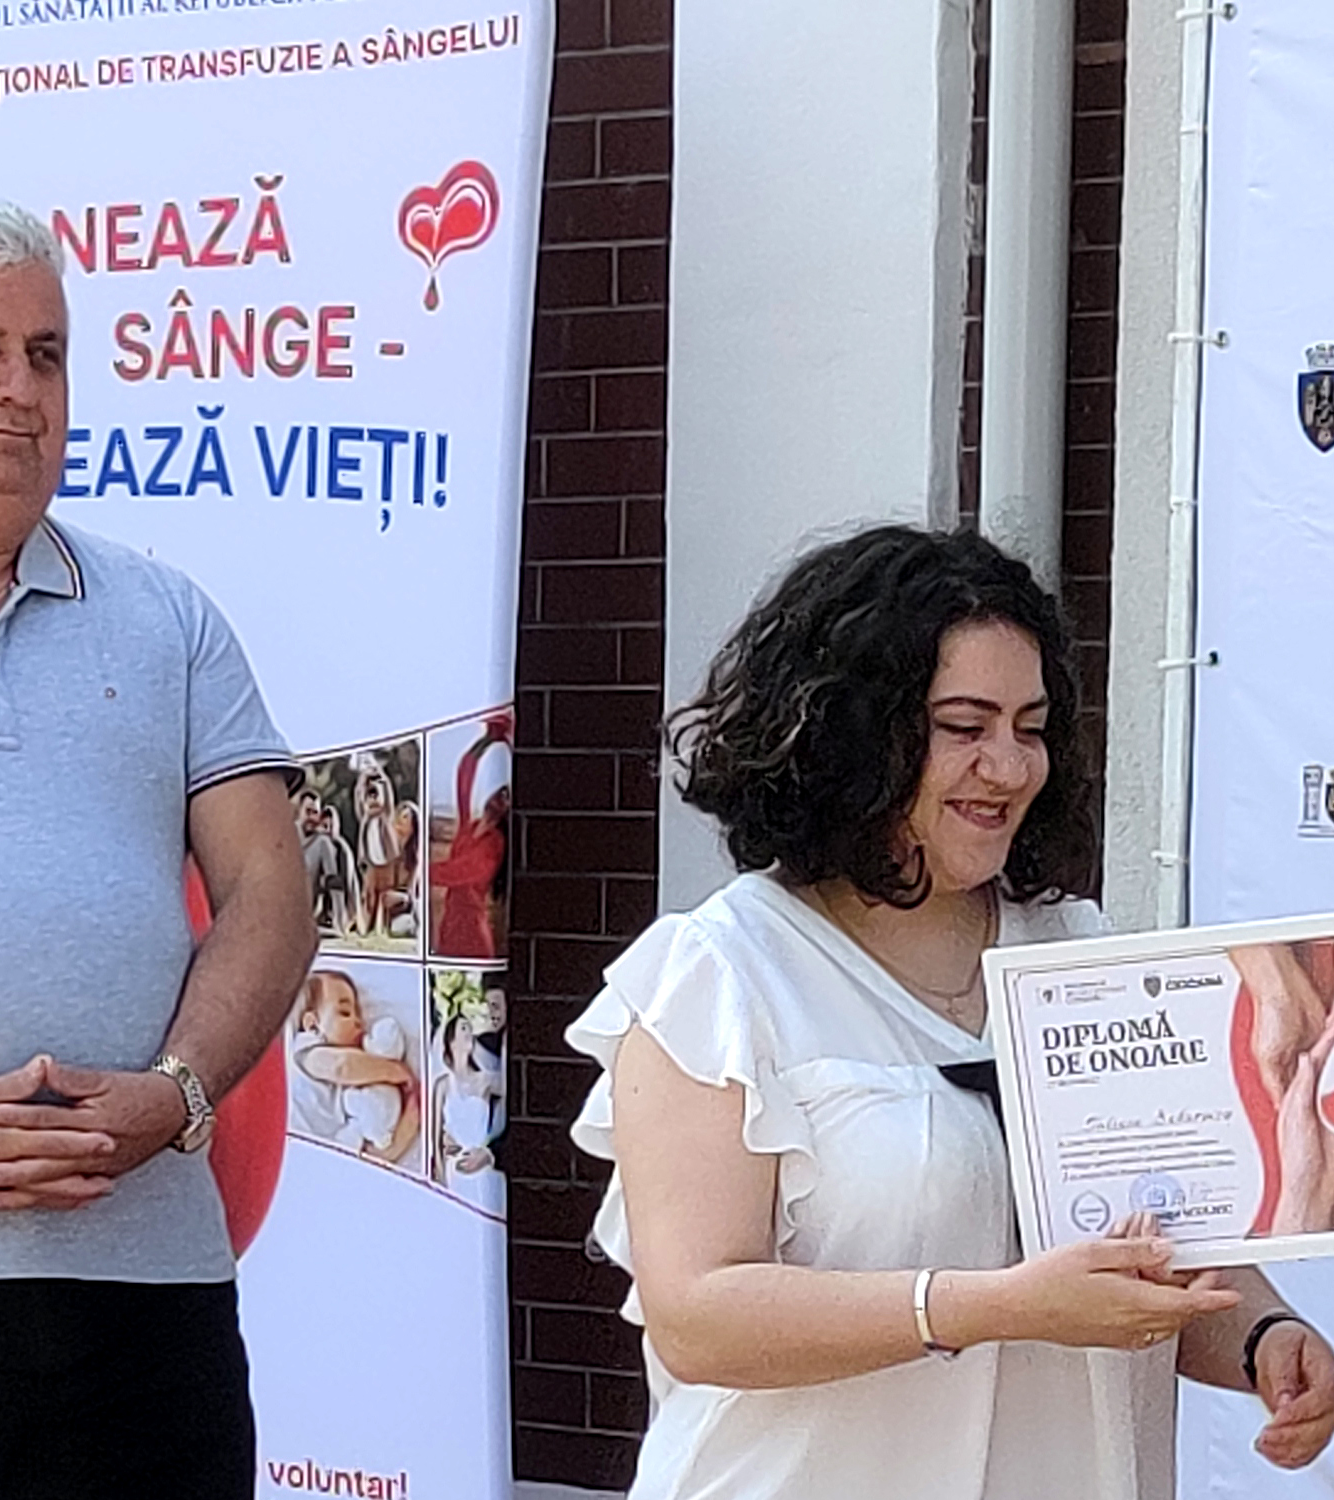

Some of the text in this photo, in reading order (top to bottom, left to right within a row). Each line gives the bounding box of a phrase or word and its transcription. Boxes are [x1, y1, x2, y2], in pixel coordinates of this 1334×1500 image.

[98, 58, 134, 86] DE
[142, 43, 323, 83] TRANSFUZIE
[331, 42, 353, 69] A
[362, 15, 520, 65] SÂNGELUI
[52, 174, 291, 274] NEAZĂ
[113, 288, 355, 382] SÂNGE
[57, 403, 449, 532] EAZĂ VIEȚI!
[1042, 1009, 1175, 1051] DIPLOMĂ
[1046, 1039, 1209, 1078] DE ONOARE
